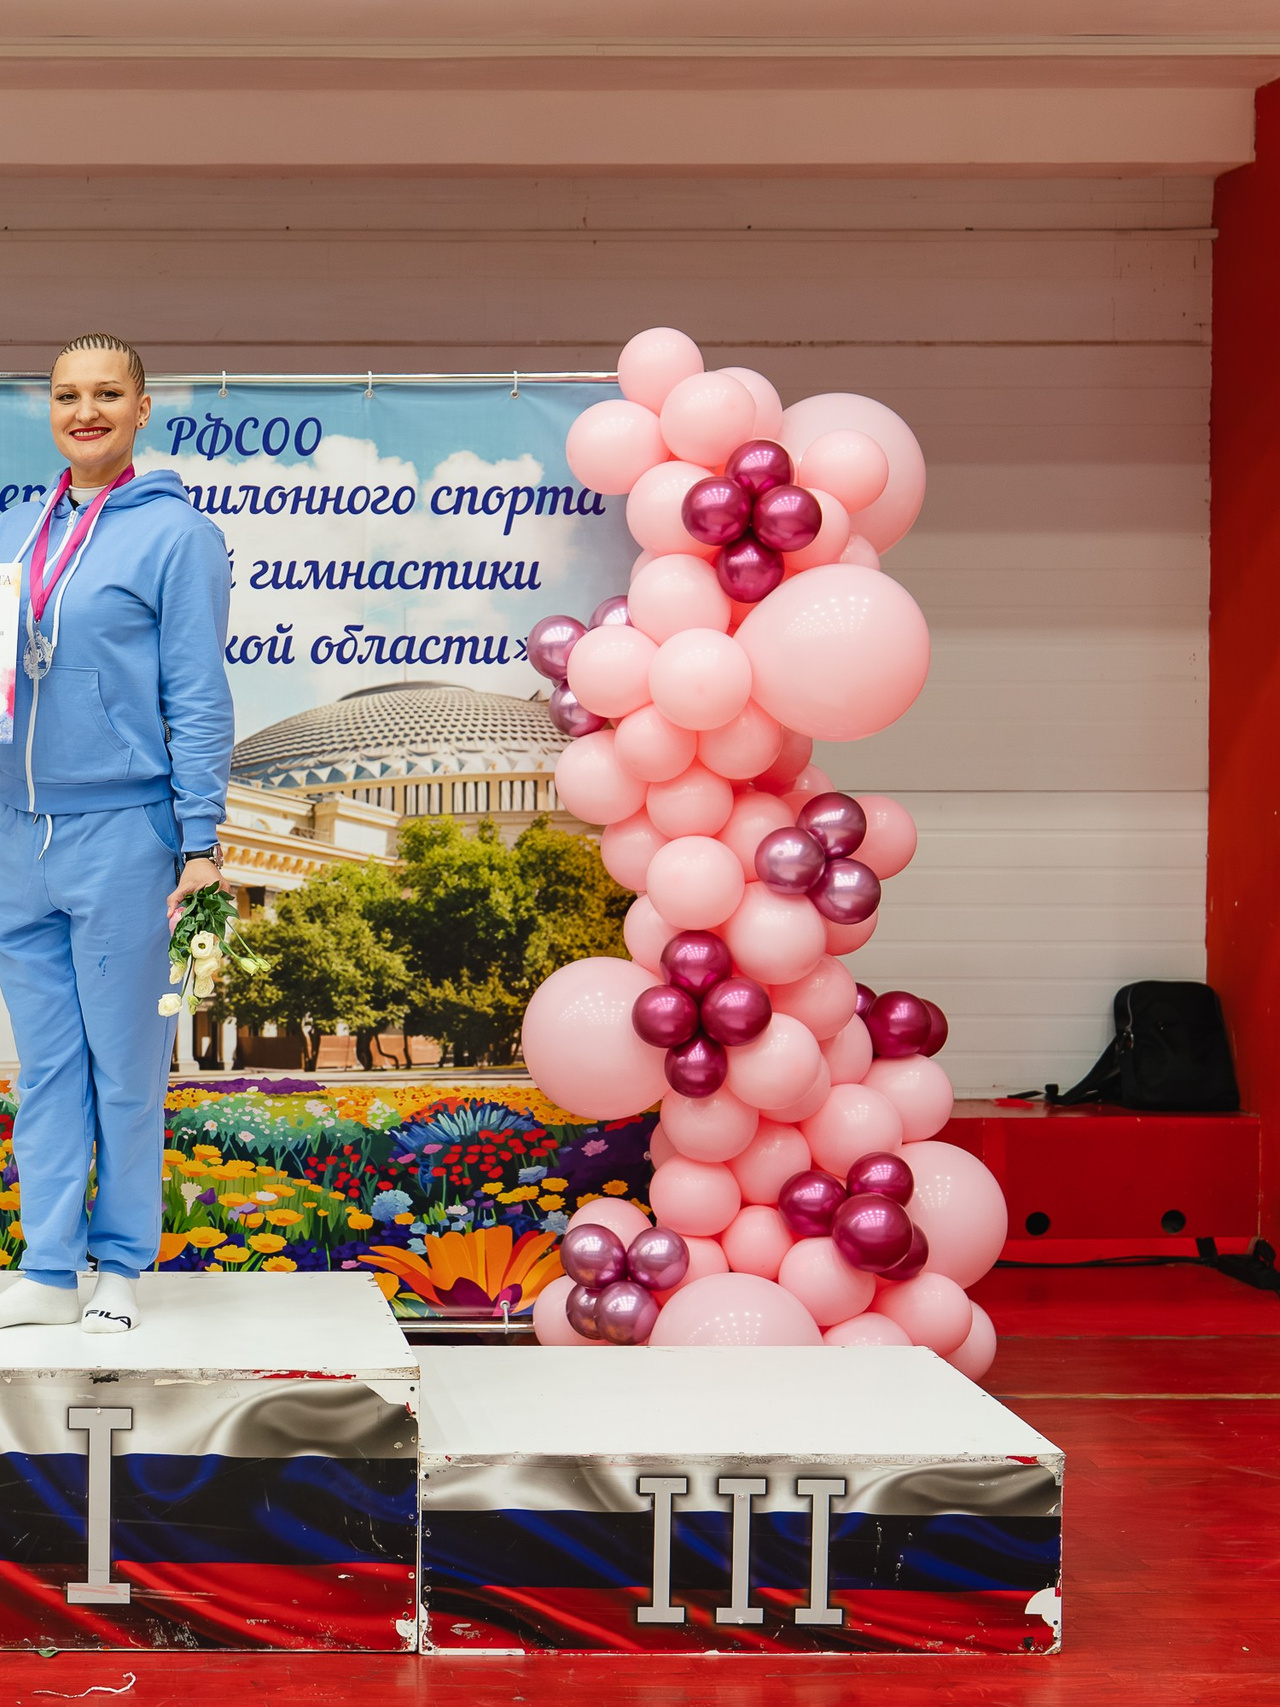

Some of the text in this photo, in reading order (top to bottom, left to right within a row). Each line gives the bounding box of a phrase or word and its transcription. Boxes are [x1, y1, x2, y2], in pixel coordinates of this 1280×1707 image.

[166, 412, 323, 461] РФСОО
[430, 484, 607, 536] спорта
[249, 560, 542, 590] гимнастики
[85, 1309, 132, 1330] FILA
[67, 1406, 134, 1604] I
[637, 1476, 847, 1625] III
